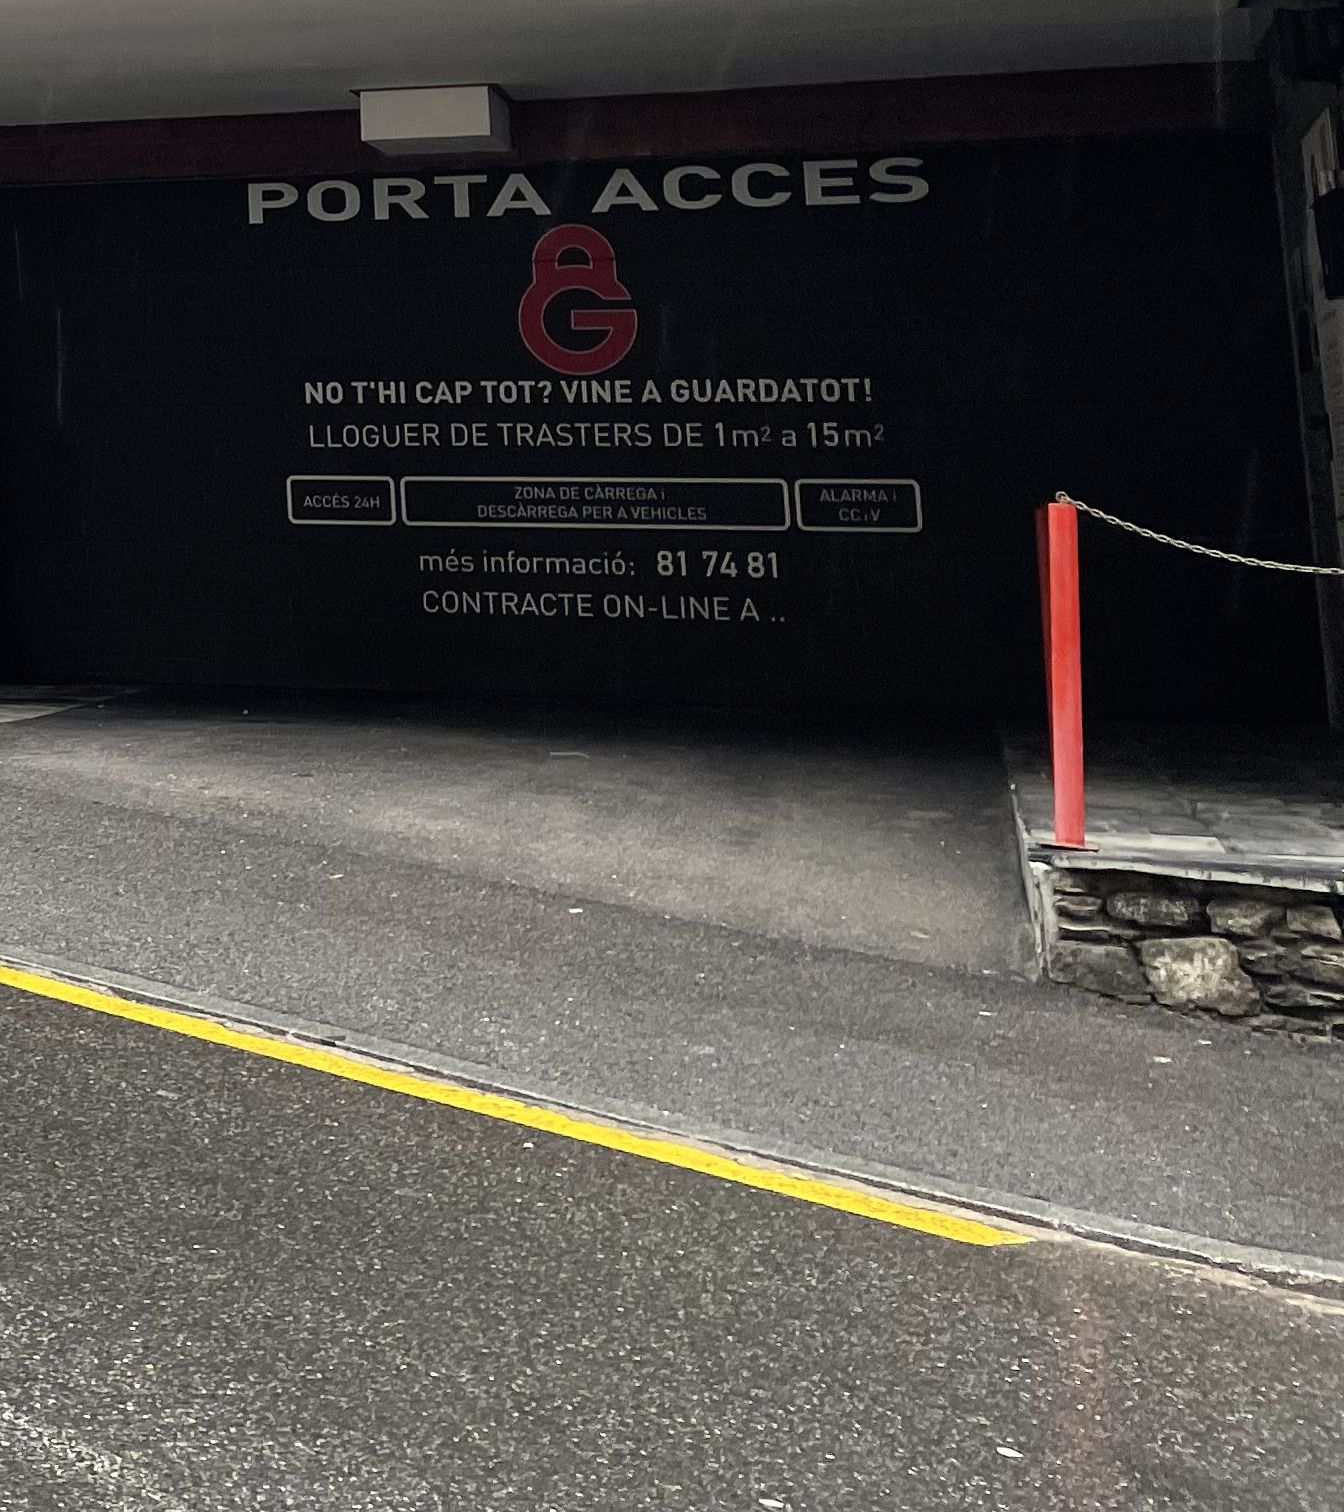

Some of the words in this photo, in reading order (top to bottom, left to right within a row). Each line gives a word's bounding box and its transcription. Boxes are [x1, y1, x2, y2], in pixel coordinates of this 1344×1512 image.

[248, 174, 551, 224] PORTA
[592, 158, 928, 213] ACCES
[305, 382, 343, 404] NO
[351, 381, 405, 403] T'HI
[416, 381, 472, 403] CAP
[480, 381, 552, 403] TOT?
[560, 380, 632, 403] VINE
[642, 380, 662, 402] A
[671, 378, 871, 402] GUARDATOT!
[310, 423, 440, 447] LLOGUER
[451, 423, 488, 446] DE
[497, 423, 652, 446] TRASTERS
[664, 423, 703, 446] DE
[782, 430, 796, 446] a
[355, 496, 379, 508] 24H
[515, 487, 555, 499] ZONA
[560, 487, 579, 499] DE
[585, 484, 657, 500] CÀRREGA
[820, 489, 888, 502] ALARMA
[478, 502, 578, 518] DESCÀRREGA
[583, 506, 612, 519] PER
[618, 506, 627, 519] A
[631, 506, 706, 520] VEHICLES
[420, 549, 474, 572] més
[484, 549, 634, 575] informació:
[658, 551, 686, 576] 81
[702, 551, 737, 577] 74
[748, 552, 777, 578] 81
[423, 591, 593, 616] CONTRACTE
[604, 595, 730, 620] ON-LINE
[741, 598, 759, 621] A
